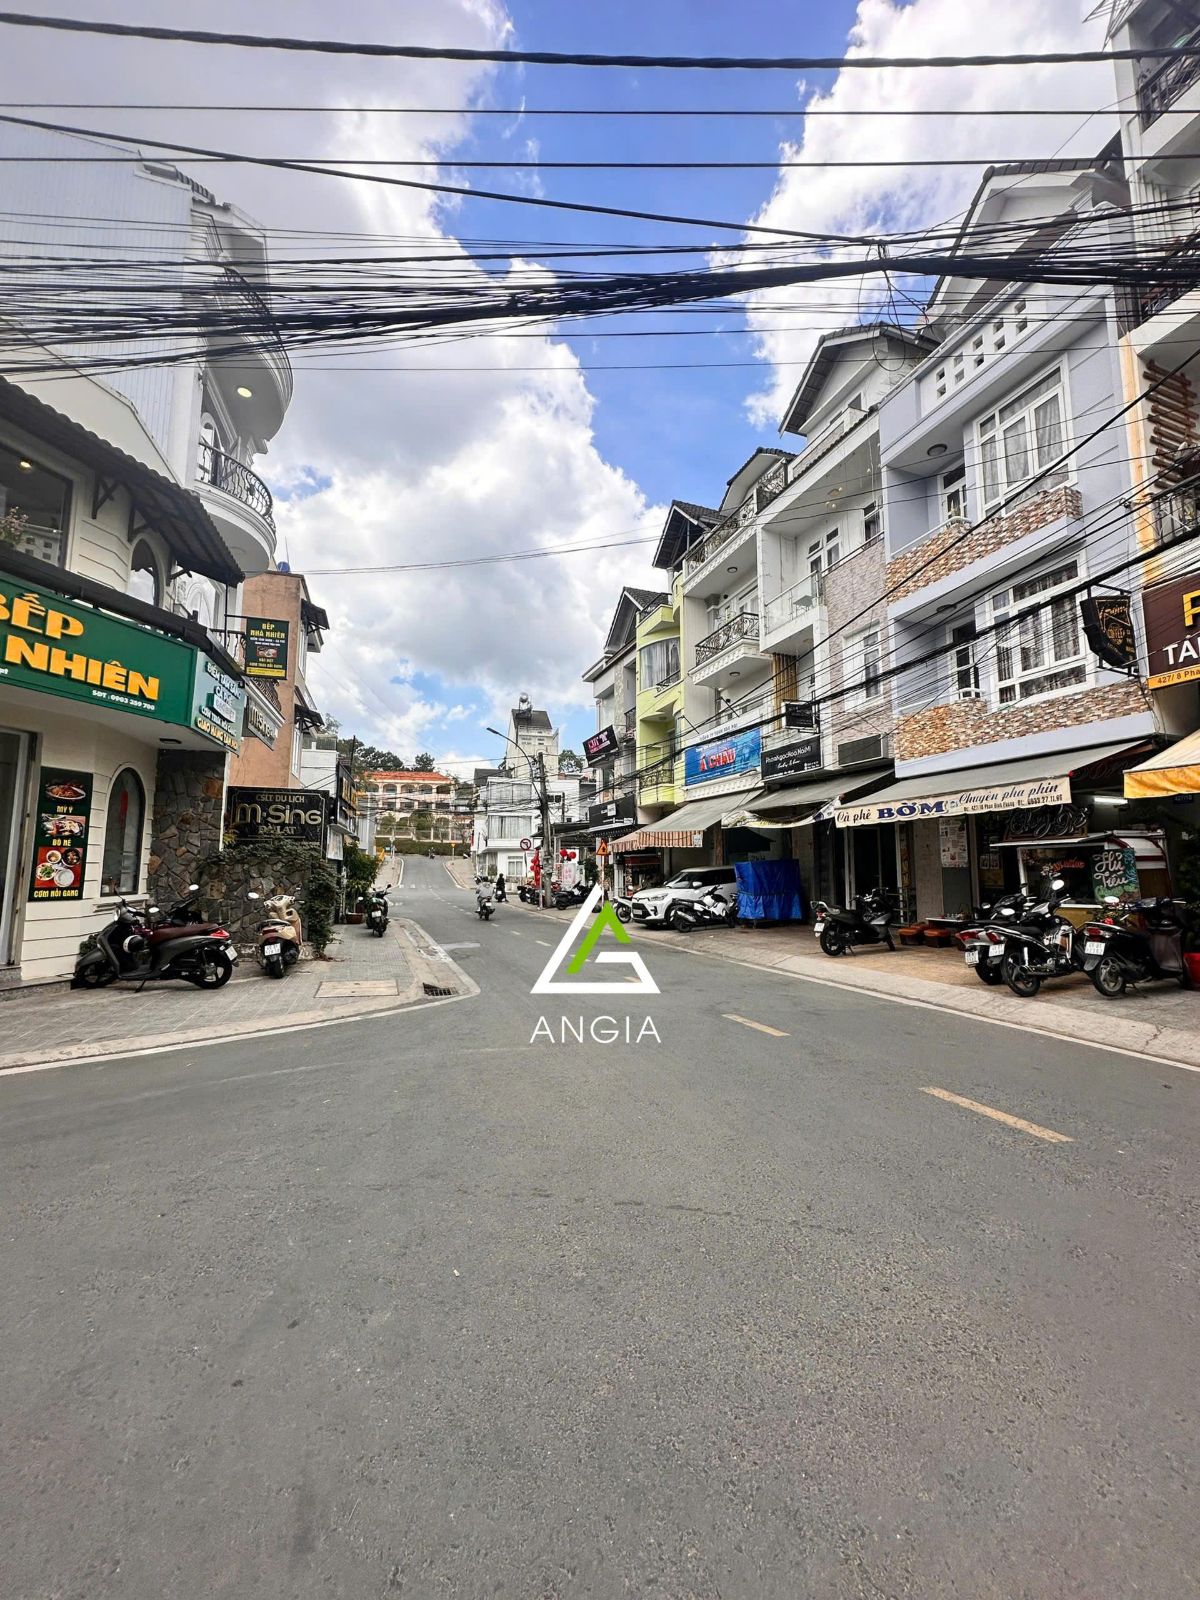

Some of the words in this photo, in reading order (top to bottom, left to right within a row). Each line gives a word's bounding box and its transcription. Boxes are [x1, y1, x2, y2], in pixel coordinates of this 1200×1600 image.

[1162, 634, 1200, 665] TÂ
[5, 634, 160, 700] NHIÊN
[275, 794, 288, 803] DU
[853, 808, 872, 823] phê
[877, 800, 945, 820] BỜM
[1001, 786, 1025, 802] pha
[1028, 782, 1059, 797] phin
[62, 888, 79, 898] GANG
